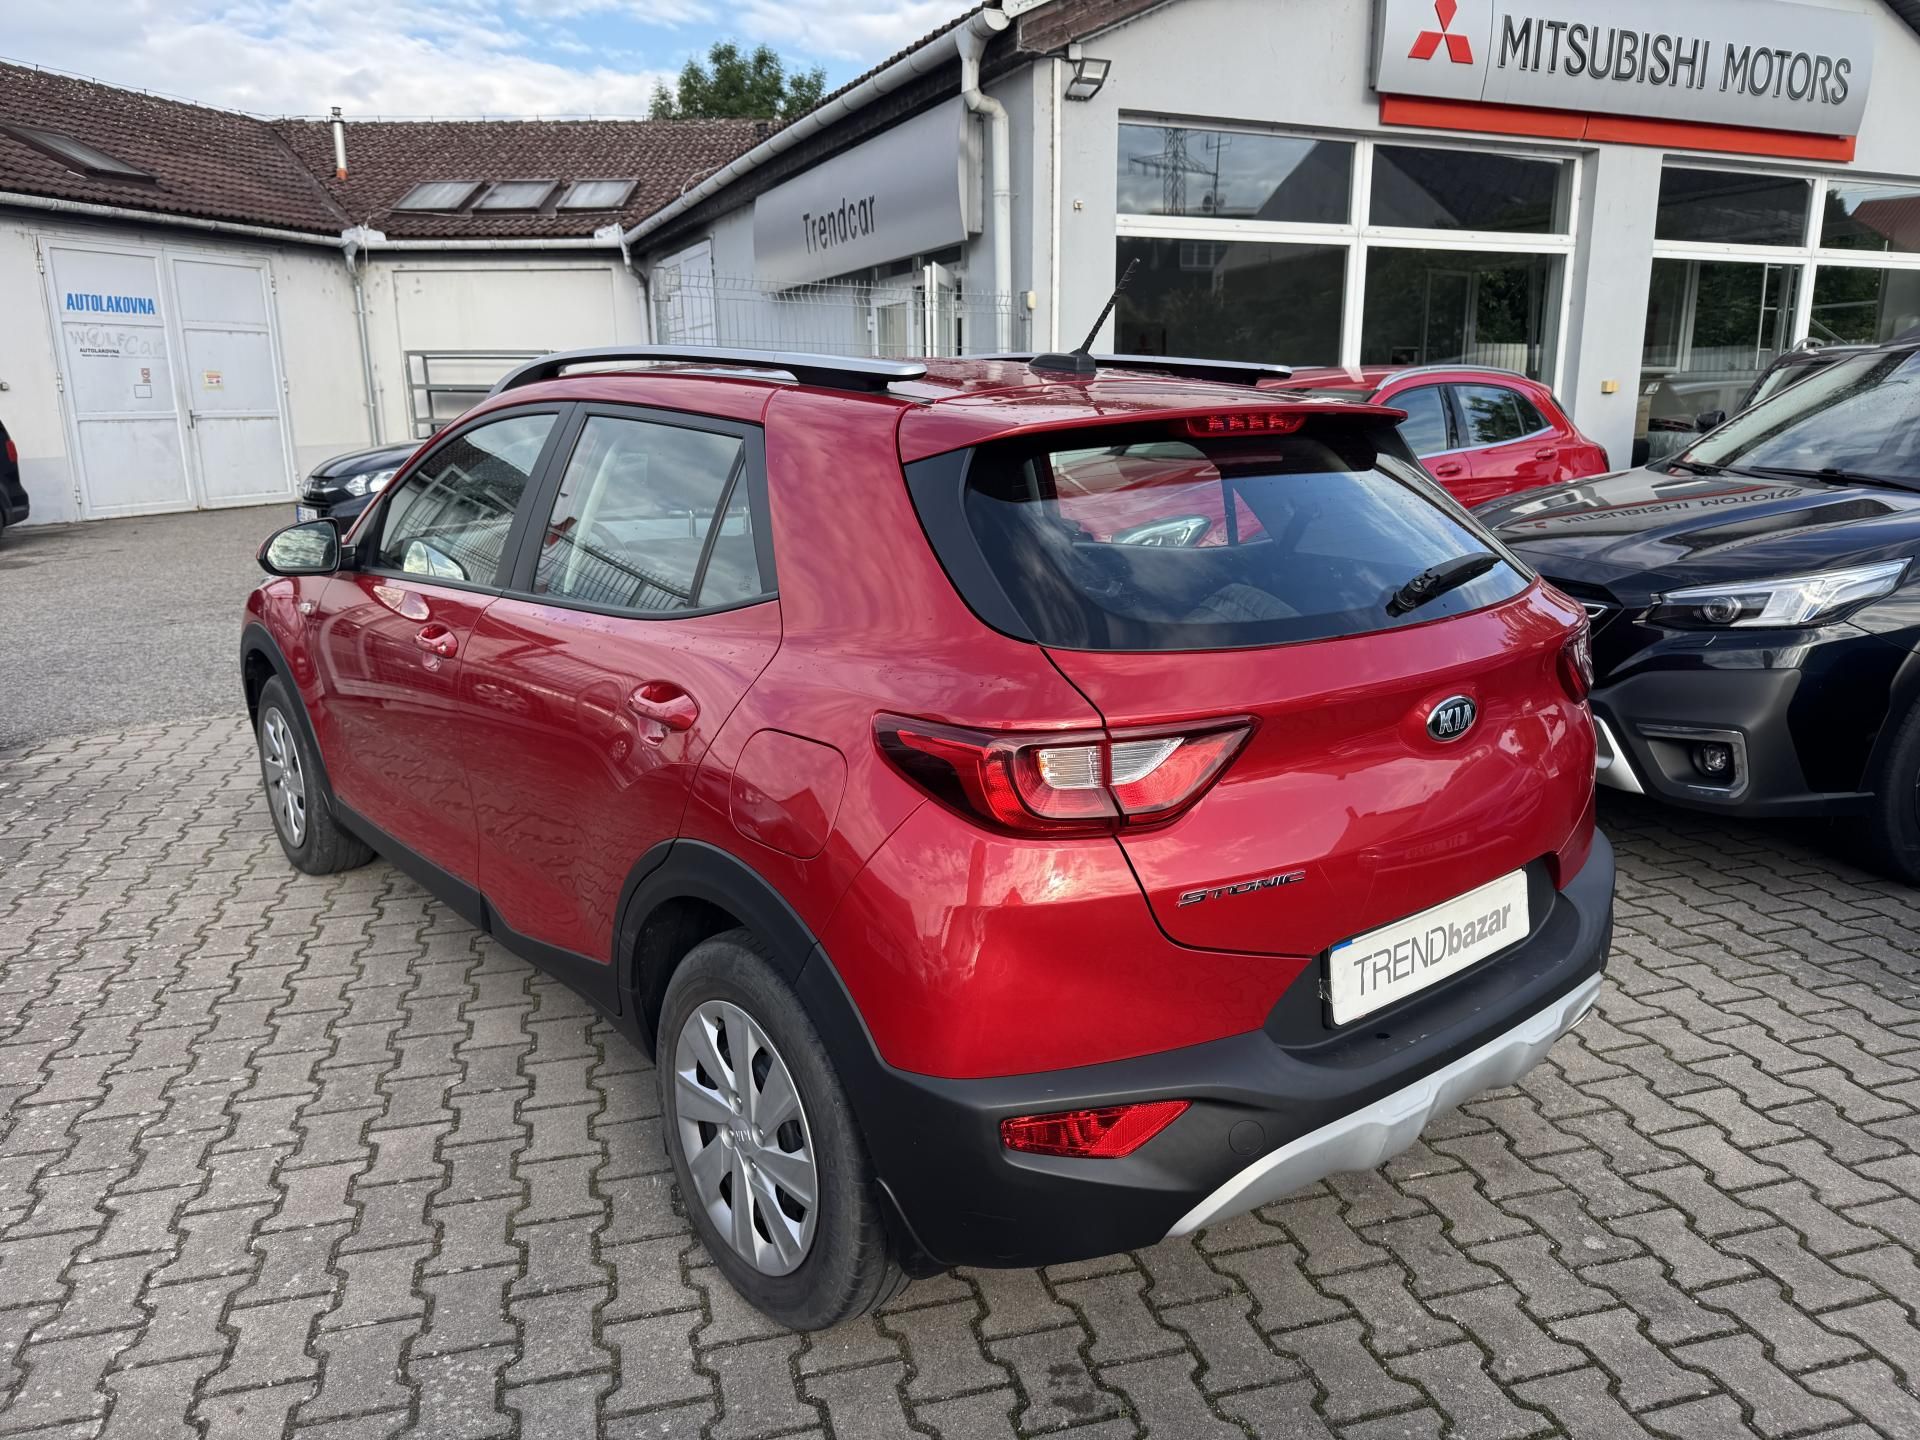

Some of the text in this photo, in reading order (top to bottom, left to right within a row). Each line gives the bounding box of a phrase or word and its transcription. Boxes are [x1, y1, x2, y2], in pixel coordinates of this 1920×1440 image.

[1498, 14, 1852, 105] MITSUBISHI MOTORS
[803, 195, 875, 253] Trendcar
[66, 293, 156, 315] AUTOLAKOVNA
[1438, 704, 1474, 735] KIA
[1176, 870, 1307, 908] STONIC
[1353, 901, 1512, 996] TRENDbazar
